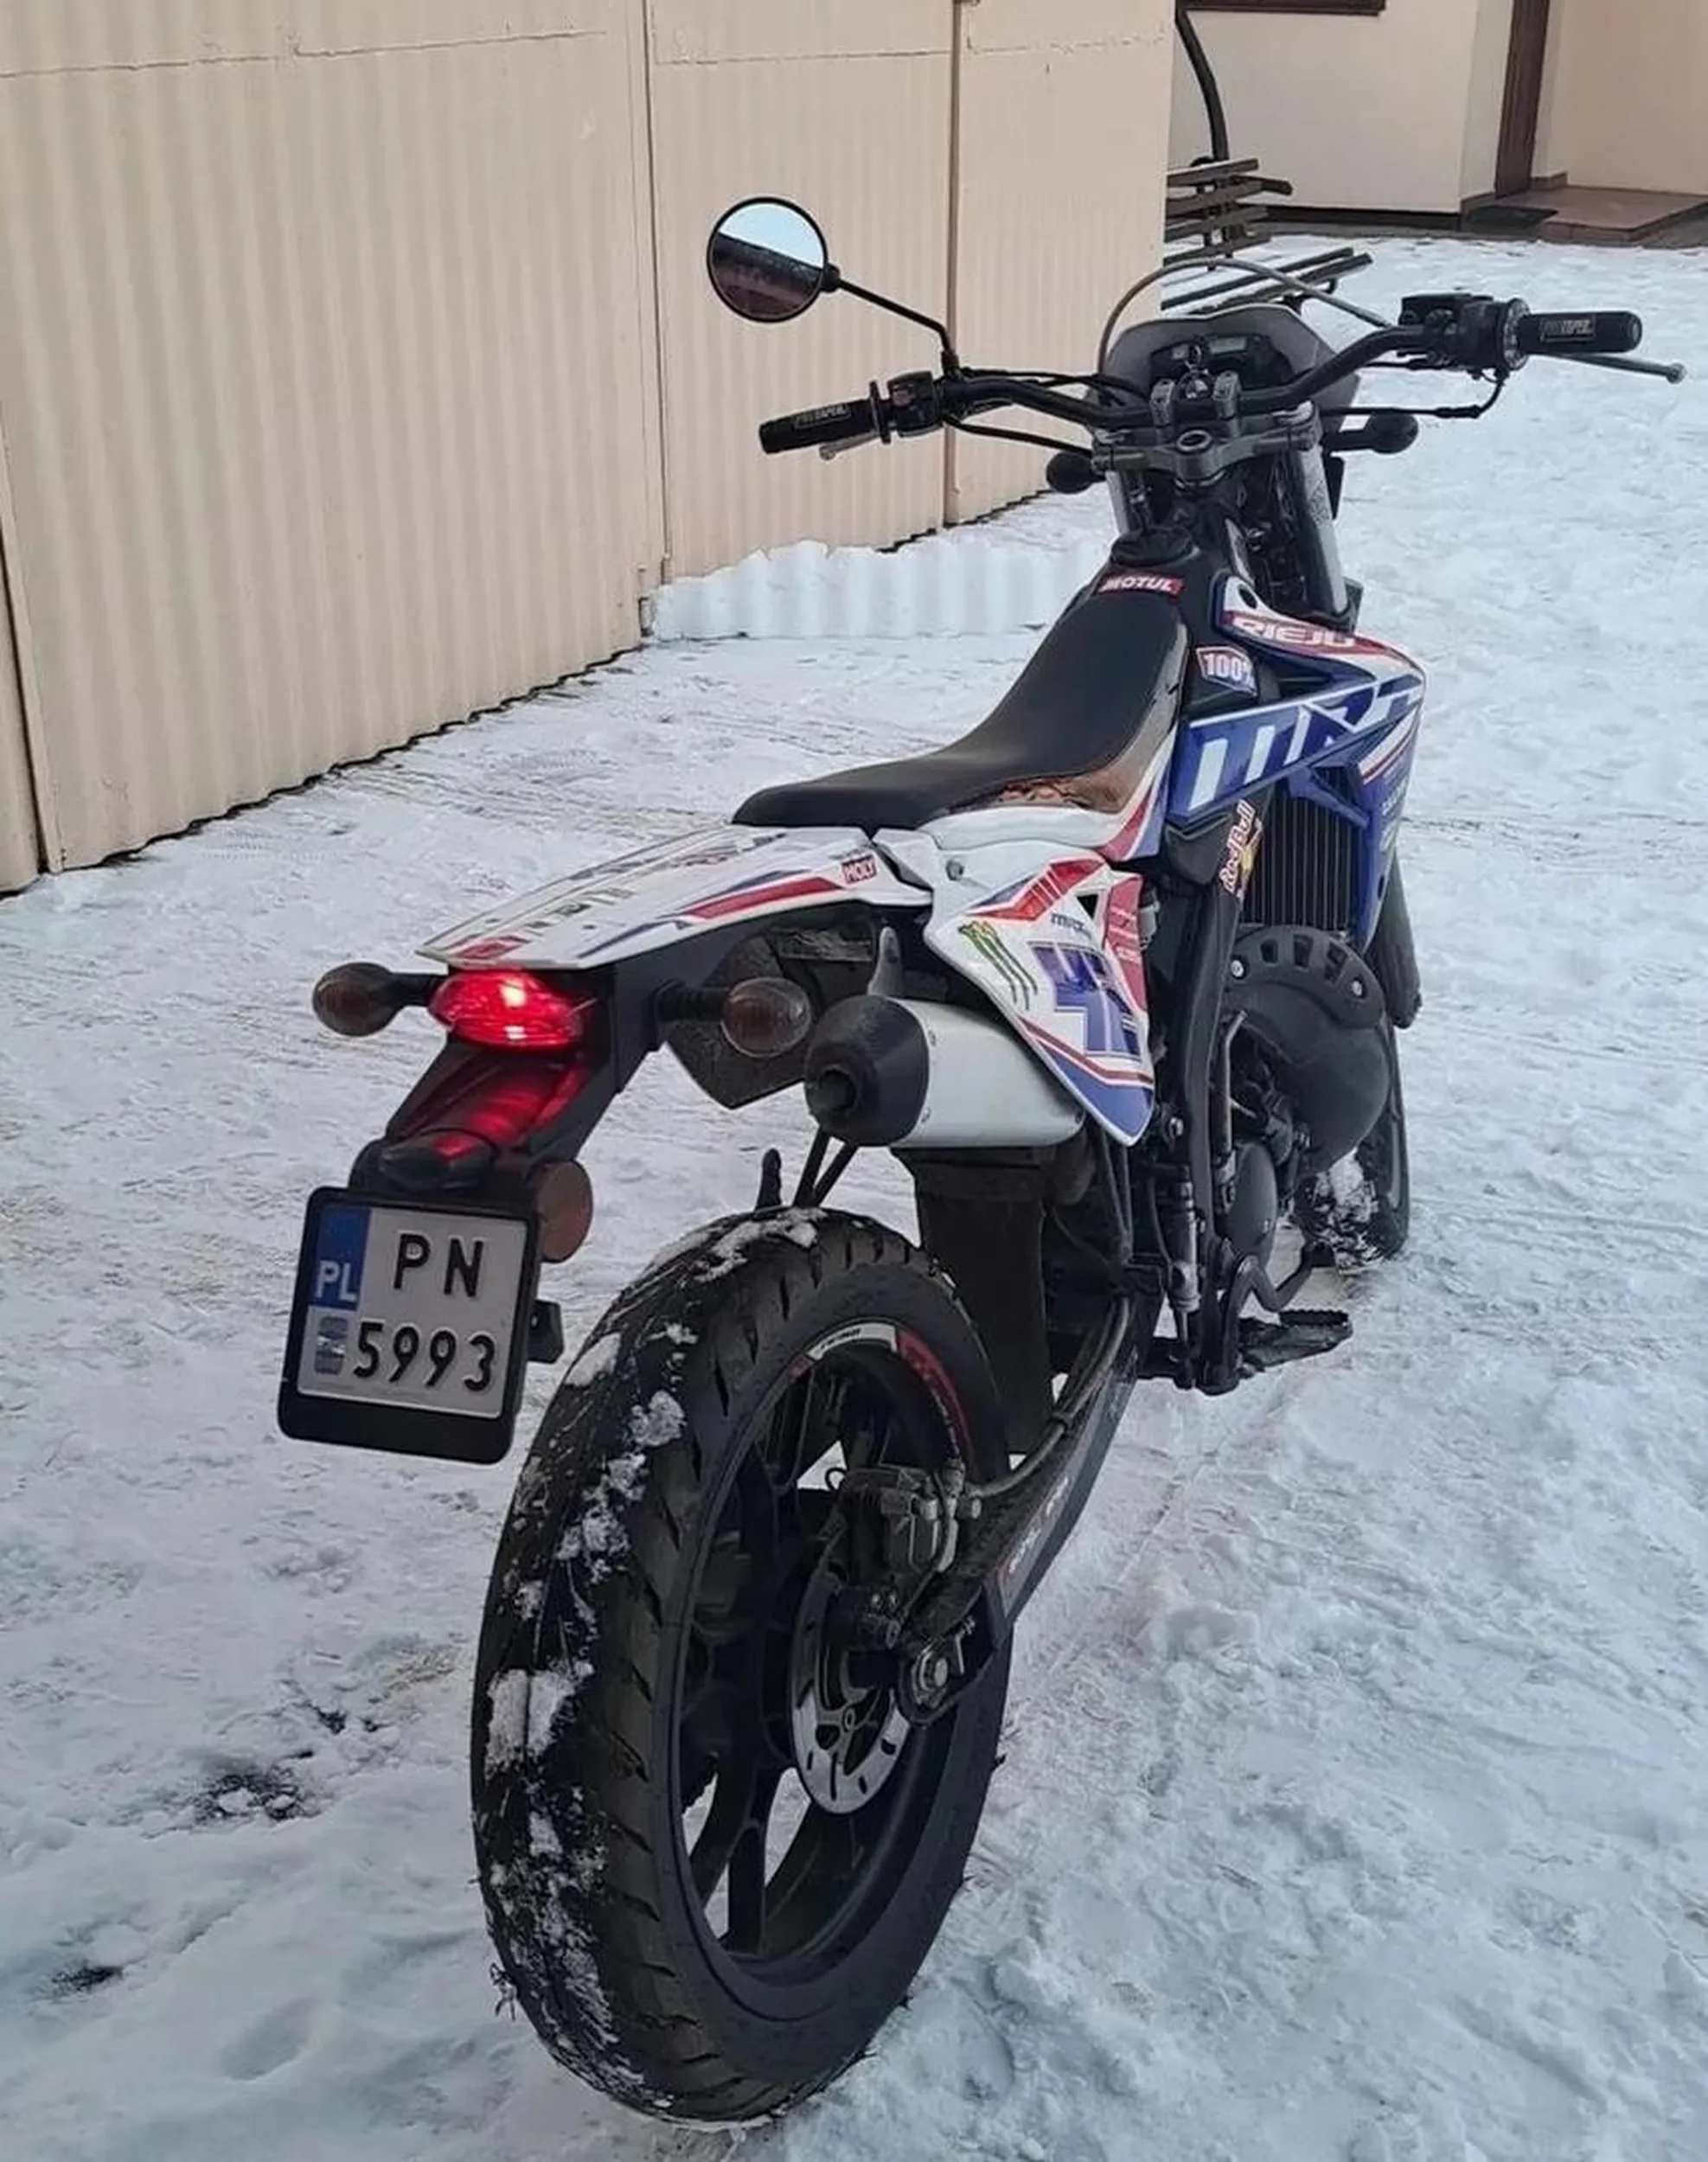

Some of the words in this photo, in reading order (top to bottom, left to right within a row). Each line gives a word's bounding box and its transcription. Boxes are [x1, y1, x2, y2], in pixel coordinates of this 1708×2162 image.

[1097, 574, 1172, 592] MOTUL
[1231, 615, 1356, 648] RIEJU
[314, 1260, 359, 1302] PL
[393, 1232, 484, 1298] PN
[352, 1321, 496, 1392] 5993
